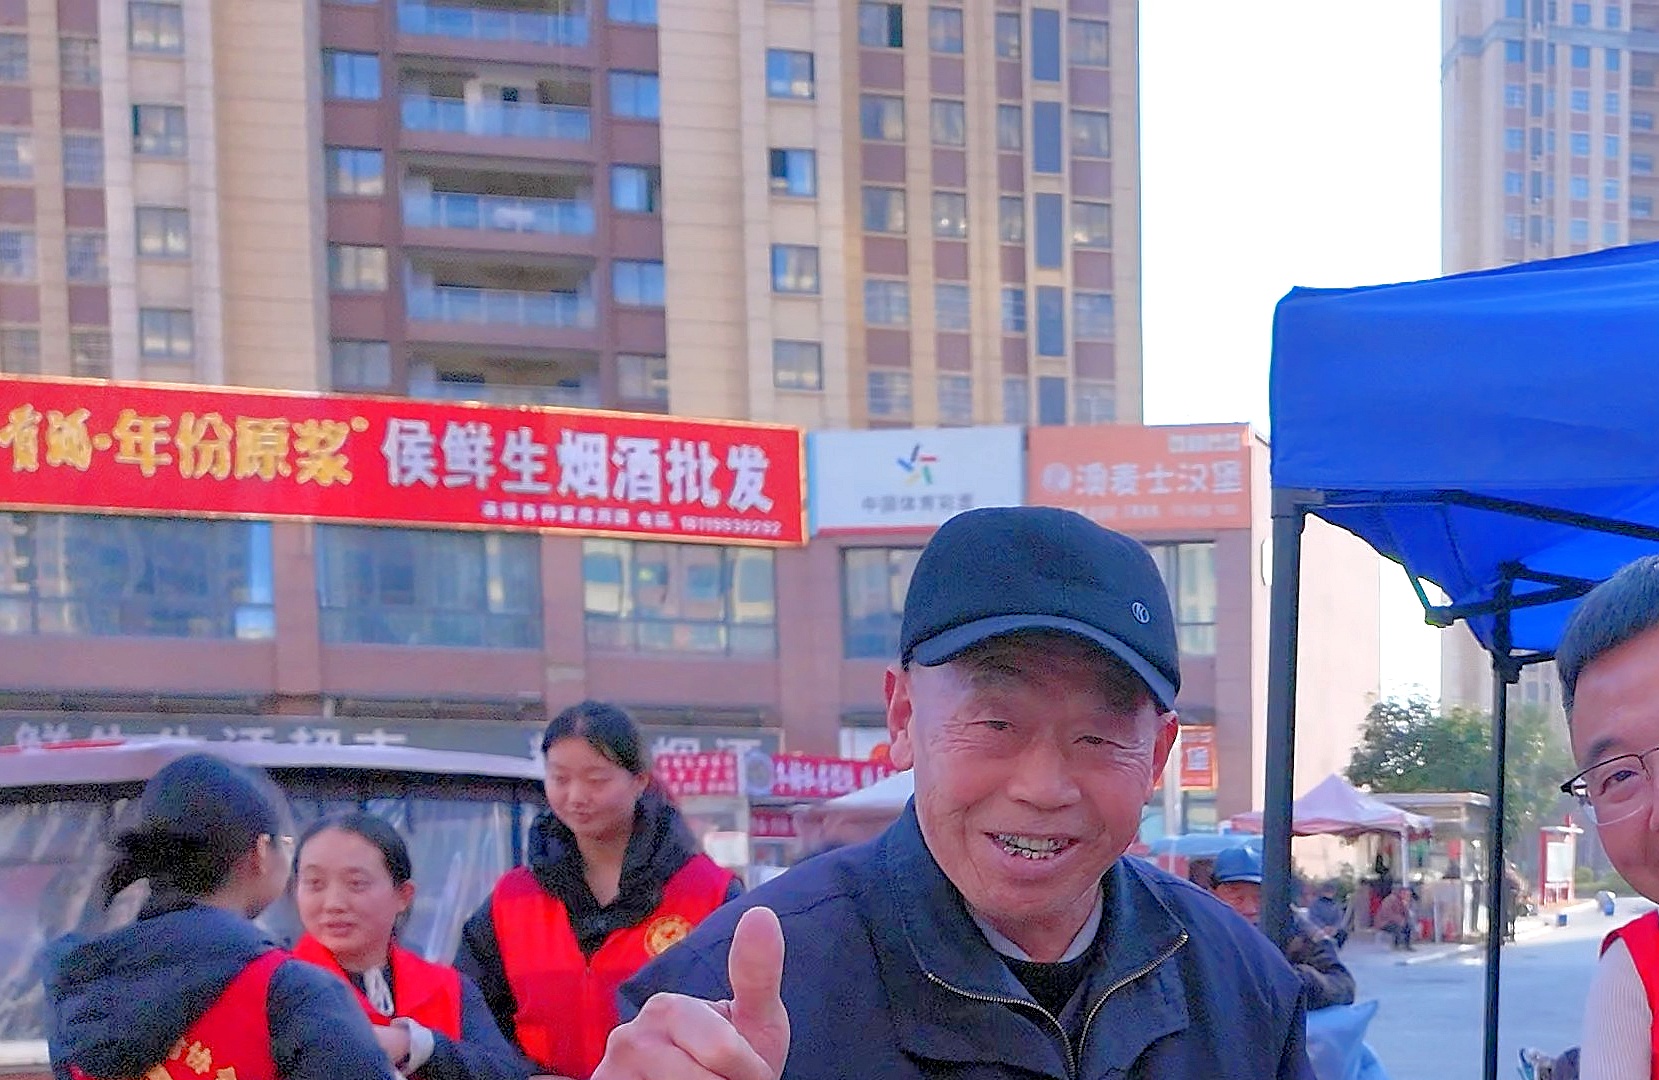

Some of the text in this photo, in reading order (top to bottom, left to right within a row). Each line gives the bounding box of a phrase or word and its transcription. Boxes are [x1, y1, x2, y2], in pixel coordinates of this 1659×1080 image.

[380, 417, 774, 513] 侯鲜生烟酒批发
